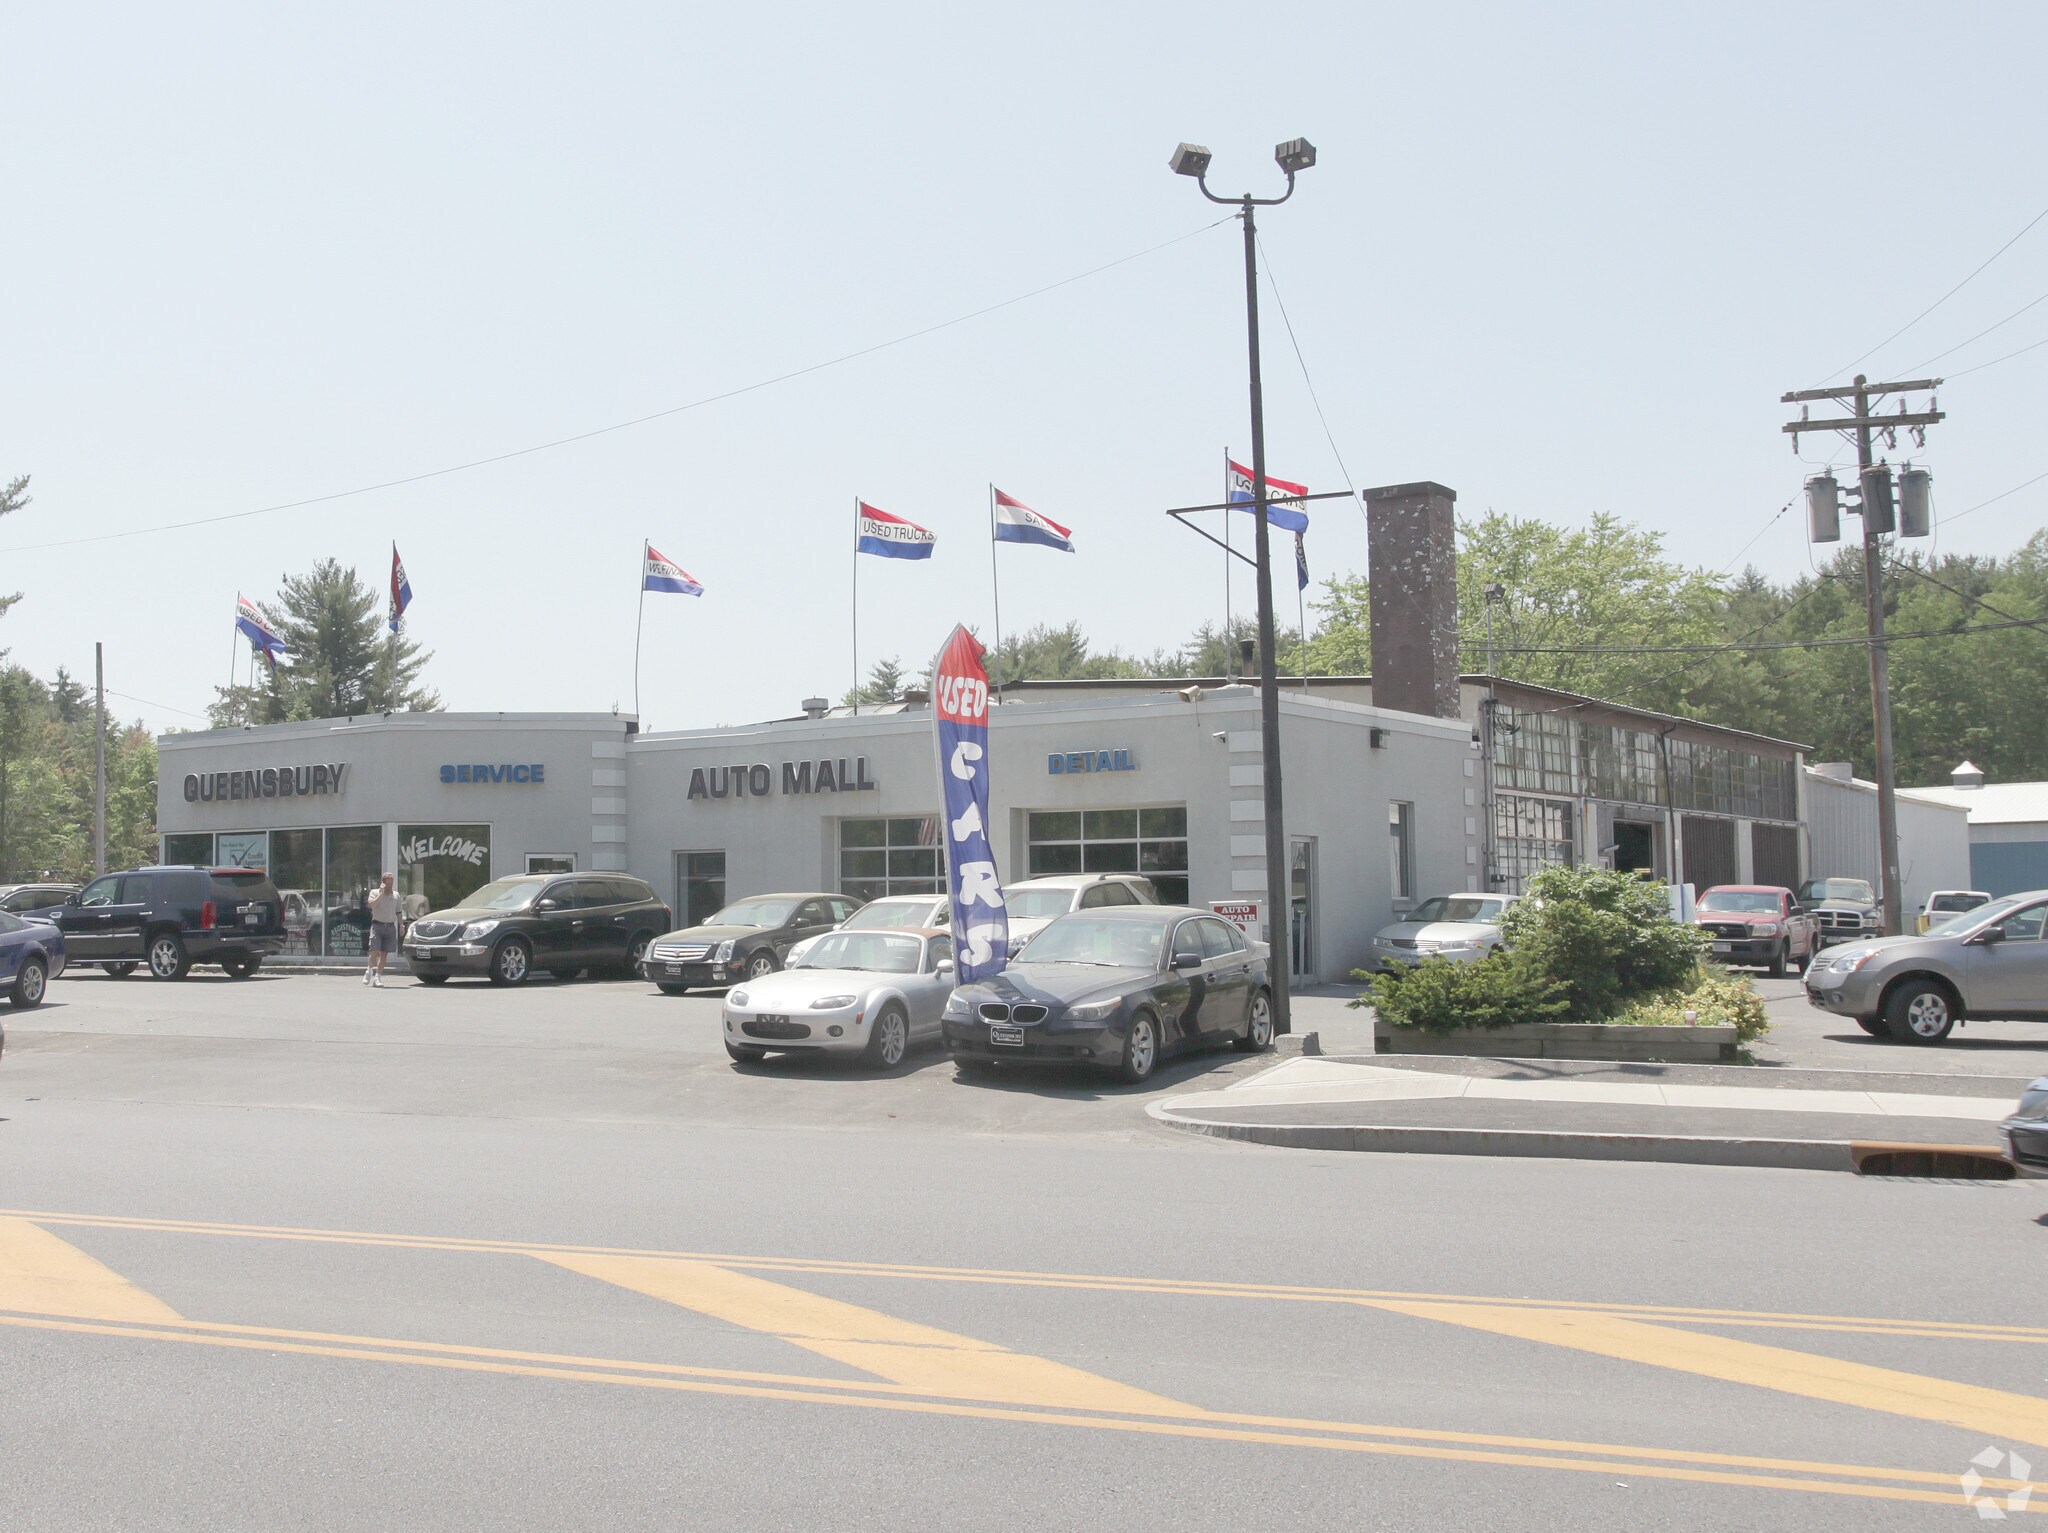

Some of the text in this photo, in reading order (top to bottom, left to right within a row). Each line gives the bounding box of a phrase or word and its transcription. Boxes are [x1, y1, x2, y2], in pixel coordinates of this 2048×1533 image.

[863, 520, 934, 540] USED TRUCKS
[1025, 512, 1049, 528] SAL
[240, 606, 262, 624] USED
[939, 675, 988, 718] USED
[1047, 749, 1136, 775] DETAIL
[183, 762, 347, 802] QUEENSBURY
[440, 764, 545, 783] SERVICE
[687, 756, 875, 800] AUTO MALL
[401, 836, 488, 866] WELCOME
[1221, 906, 1250, 914] AUTO
[1226, 914, 1256, 922] EPAIR
